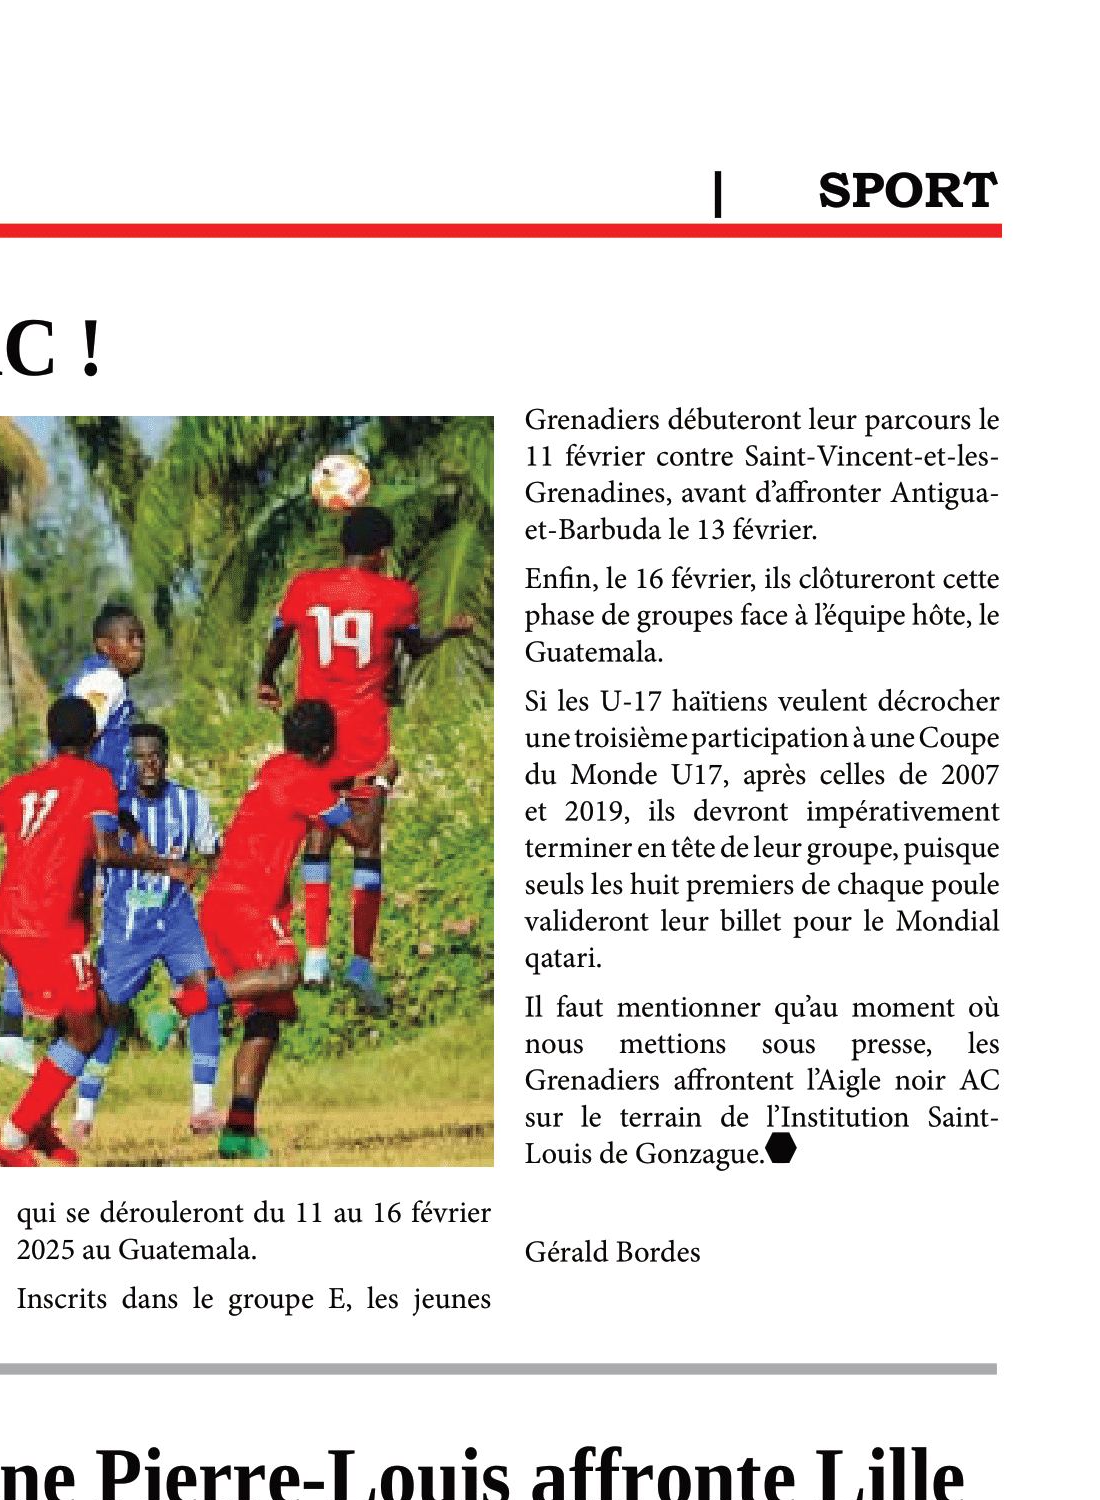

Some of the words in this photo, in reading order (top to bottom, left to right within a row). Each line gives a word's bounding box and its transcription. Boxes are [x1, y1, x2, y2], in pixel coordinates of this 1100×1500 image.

[819, 171, 999, 209] SPORT
[83, 319, 98, 377] !
[527, 445, 552, 467] 11
[565, 443, 646, 467] février
[656, 447, 734, 467] contre
[745, 443, 999, 467] Saint-Vincent-et-les-
[524, 565, 599, 592] Enfin,
[605, 565, 627, 589] le
[637, 567, 664, 590] 16
[671, 565, 756, 593] février,
[764, 565, 791, 589] ils
[799, 565, 936, 590] clôtureront
[943, 569, 1000, 590] cette
[305, 603, 374, 669] 19
[525, 946, 602, 976] qatari.
[17, 1201, 57, 1231] qui
[66, 1207, 90, 1223] se
[100, 1199, 245, 1224] dérouleront
[253, 1199, 286, 1223] du
[297, 1202, 322, 1223] 11
[334, 1207, 363, 1223] au
[374, 1201, 402, 1224] 16
[411, 1199, 492, 1223] février
[525, 1239, 609, 1263] Gérald
[616, 1239, 701, 1263] Bordes
